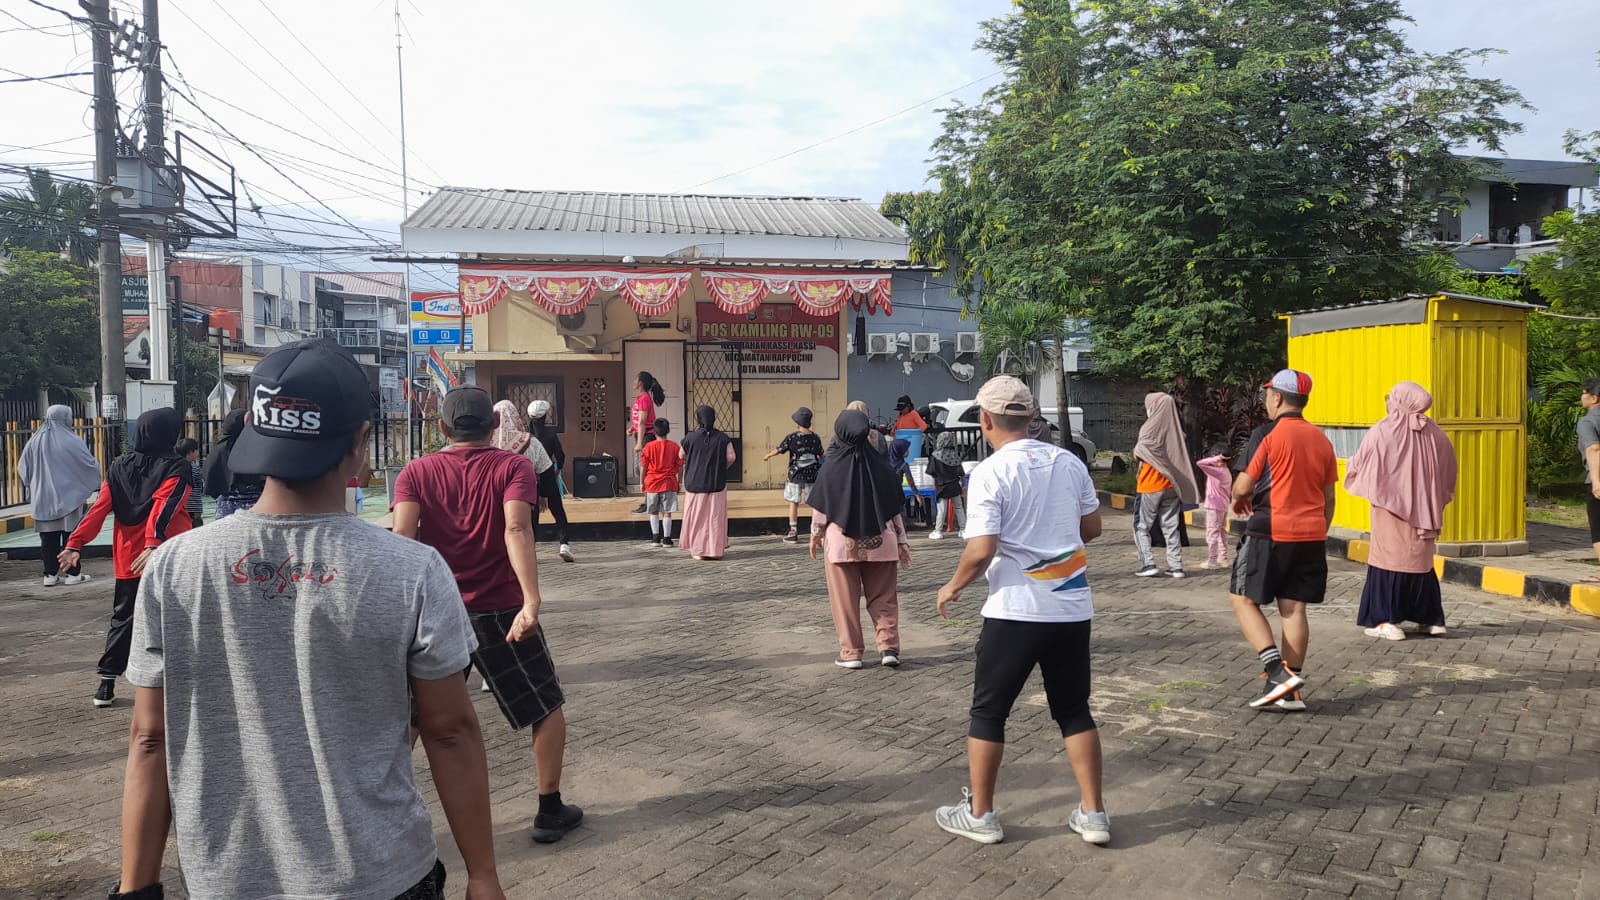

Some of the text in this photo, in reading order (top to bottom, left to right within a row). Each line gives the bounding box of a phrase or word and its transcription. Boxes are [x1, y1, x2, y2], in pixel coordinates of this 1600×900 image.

[122, 277, 148, 286] ASJID
[125, 289, 148, 297] MUHAJ
[428, 301, 461, 311] Indo
[702, 323, 834, 338] POS KAMLING RW-09
[759, 365, 801, 374] MAKASSAR
